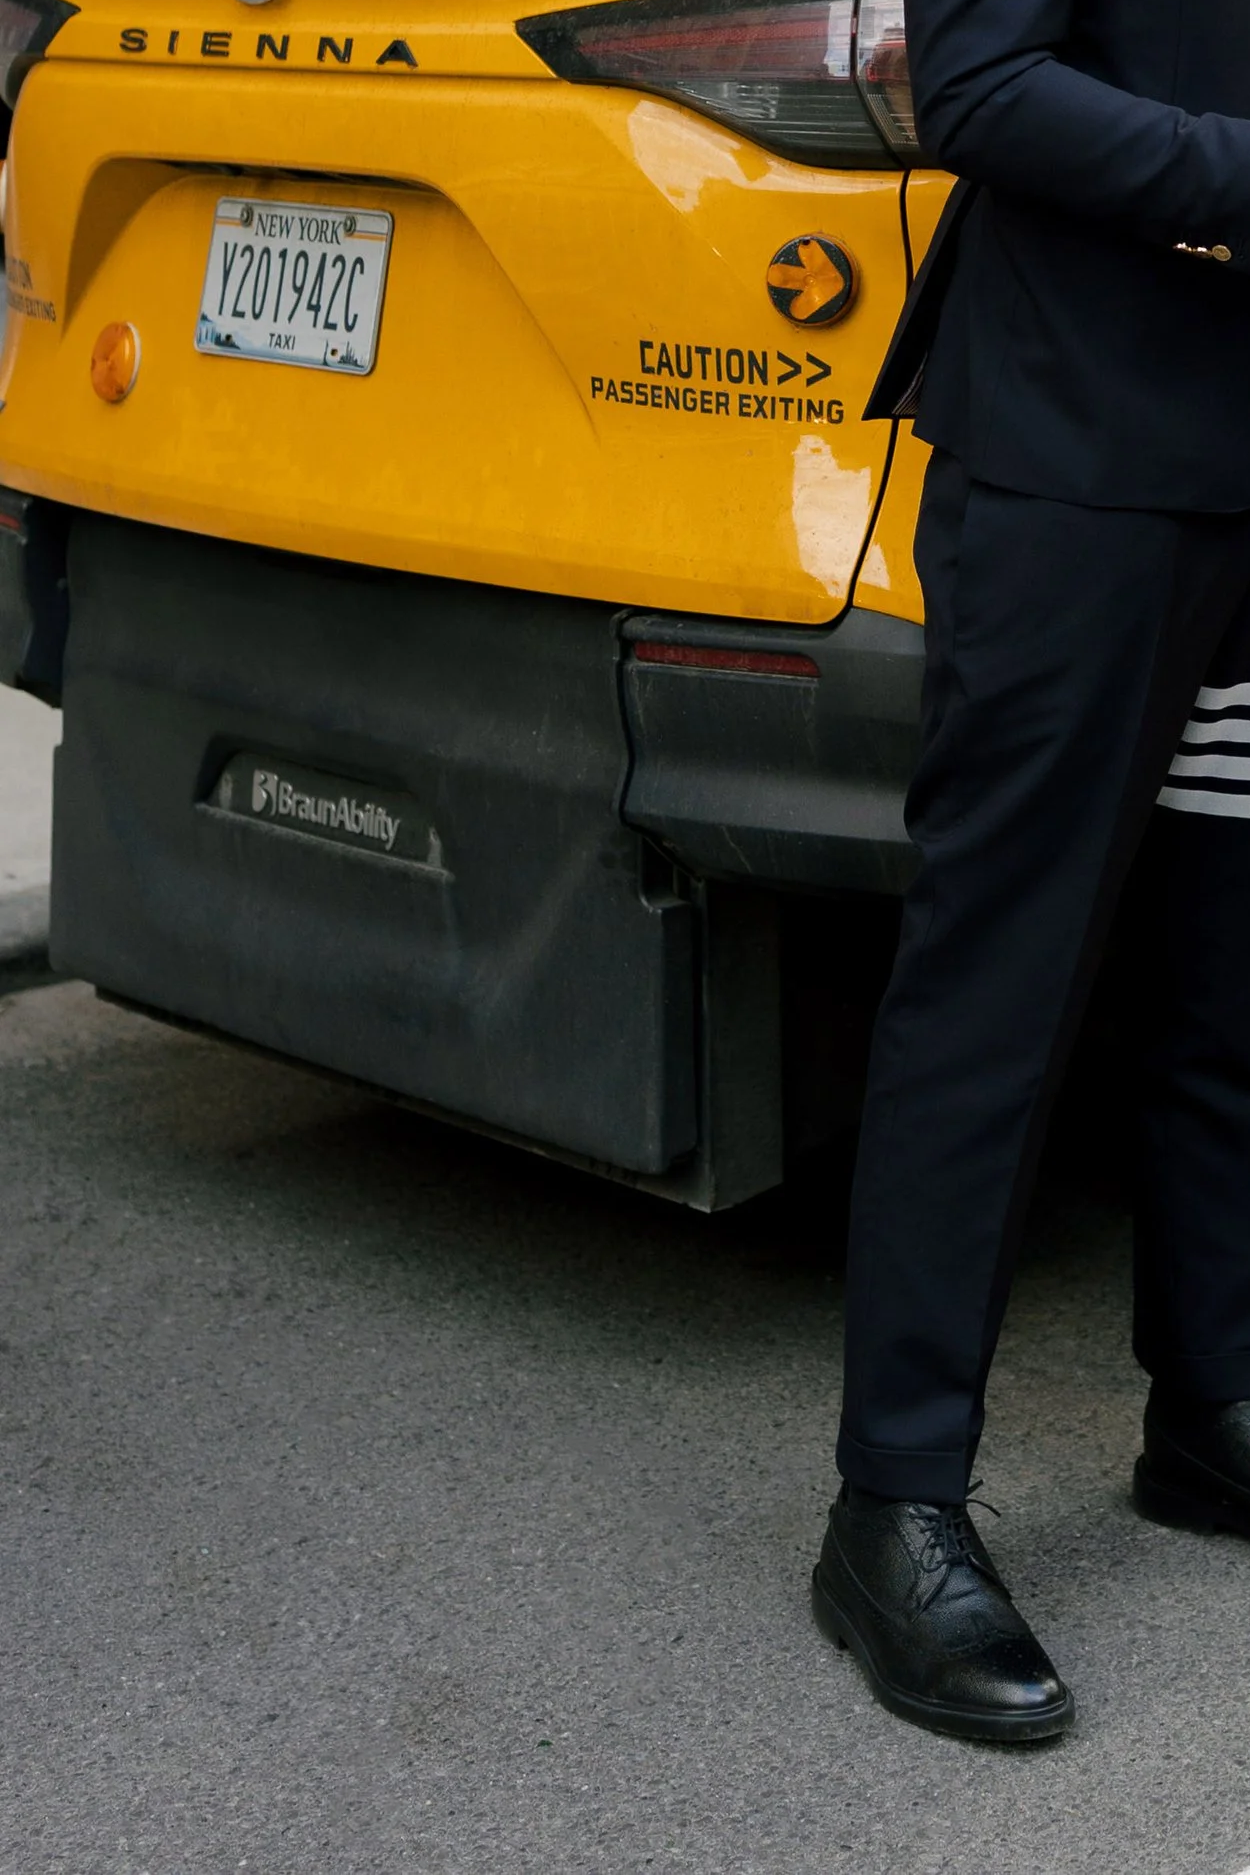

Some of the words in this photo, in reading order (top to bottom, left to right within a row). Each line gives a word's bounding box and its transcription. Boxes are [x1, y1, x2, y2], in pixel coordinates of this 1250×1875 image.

[119, 27, 418, 69] SIENNA
[255, 213, 295, 240] NEW
[298, 216, 344, 245] YORK
[218, 241, 365, 333] Y201942C
[269, 332, 296, 351] TAXI
[639, 339, 768, 386] CAUTION
[591, 376, 730, 416] PASSENGER
[738, 394, 844, 425] EXITING
[278, 781, 400, 851] BraunAbility
